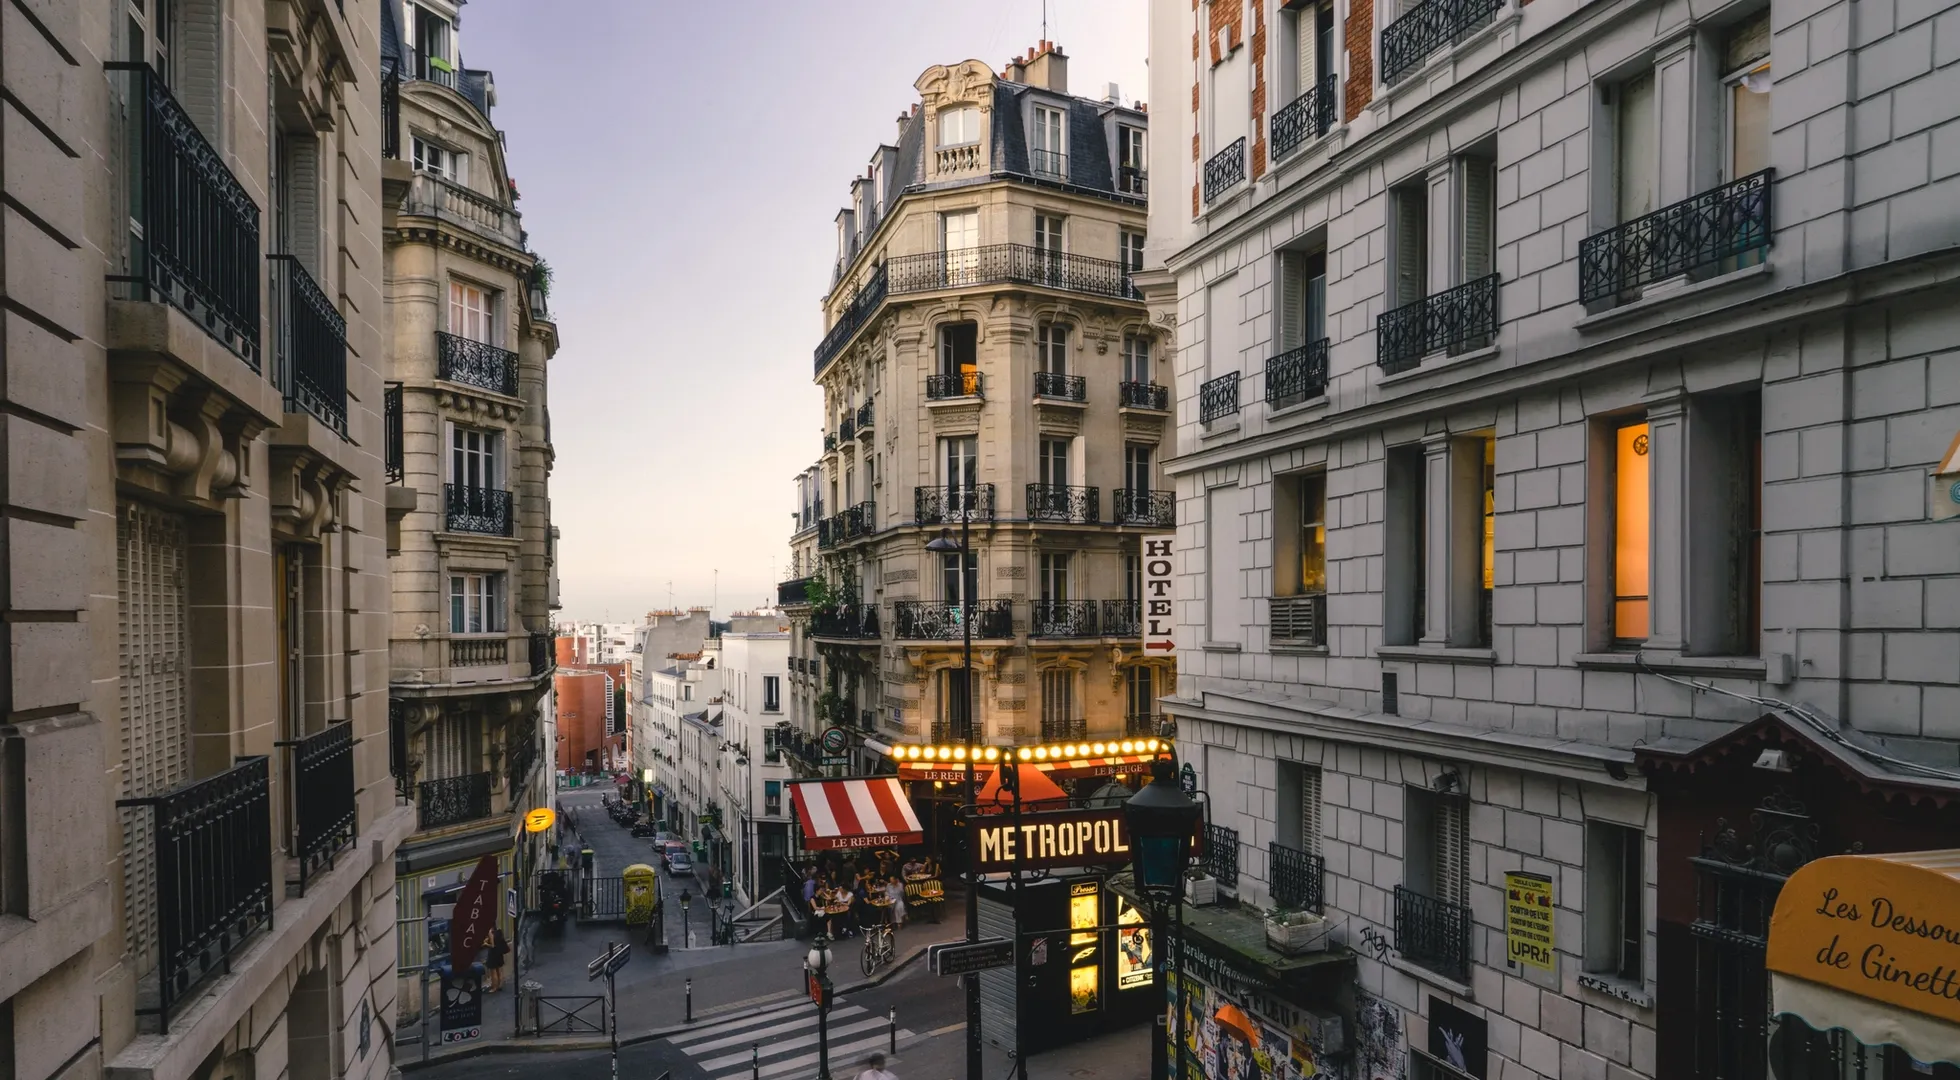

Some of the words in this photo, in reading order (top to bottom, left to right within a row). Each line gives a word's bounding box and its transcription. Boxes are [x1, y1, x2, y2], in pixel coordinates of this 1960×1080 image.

[1146, 540, 1173, 636] HOTEL
[924, 771, 938, 780] LE
[940, 771, 983, 781] REFUE
[1094, 767, 1106, 776] LE
[832, 838, 848, 848] LE
[850, 836, 898, 847] REFUGE
[463, 879, 489, 949] TABAC
[1816, 887, 1862, 921] Les
[1511, 939, 1550, 965] UPR.fr
[1816, 934, 1851, 970] de
[444, 1028, 480, 1042] LOTO
